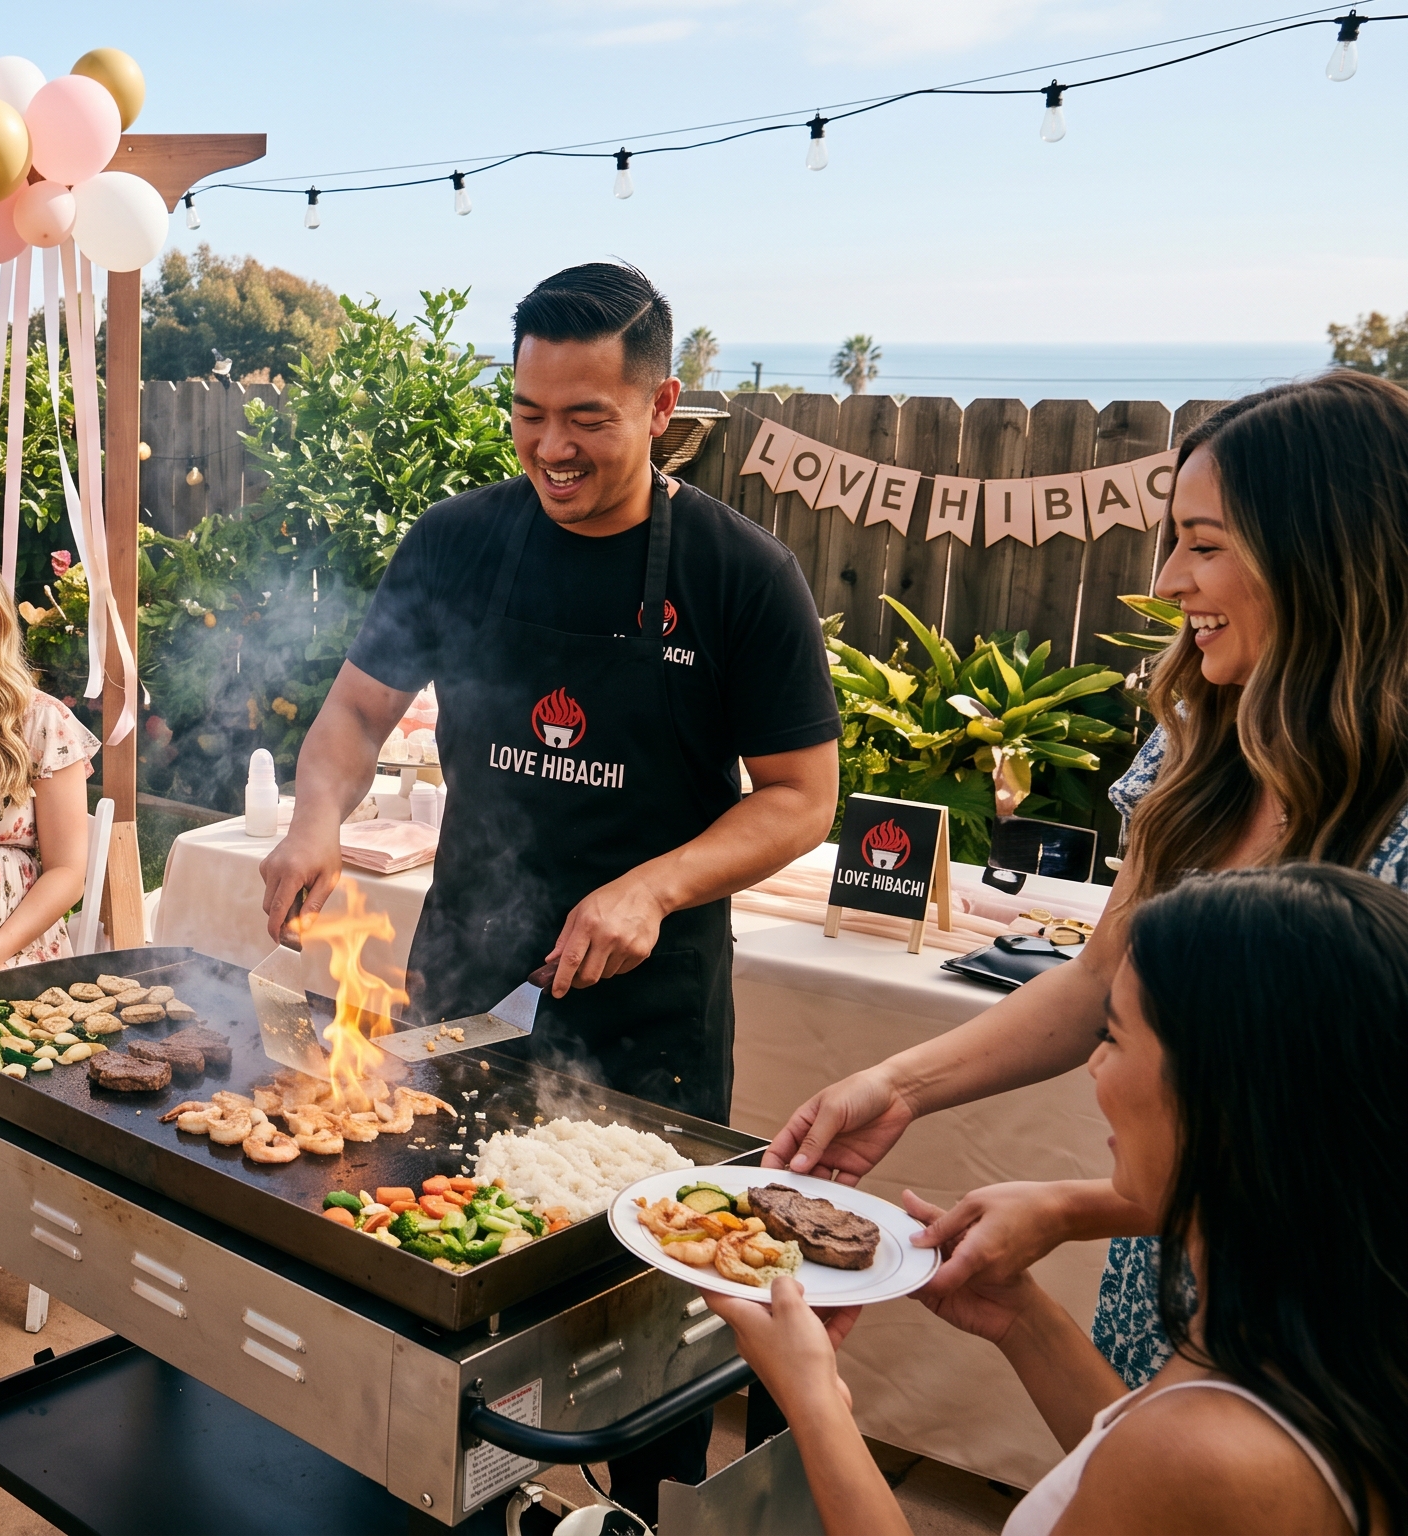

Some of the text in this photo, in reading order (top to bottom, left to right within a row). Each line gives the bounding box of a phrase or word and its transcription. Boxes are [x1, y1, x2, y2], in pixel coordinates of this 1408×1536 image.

[757, 433, 1173, 522] LOVE HIBAC
[662, 646, 695, 666] ACHI
[490, 743, 625, 789] LOVE HIBACHI
[837, 869, 925, 897] LOVE HIBACHI
